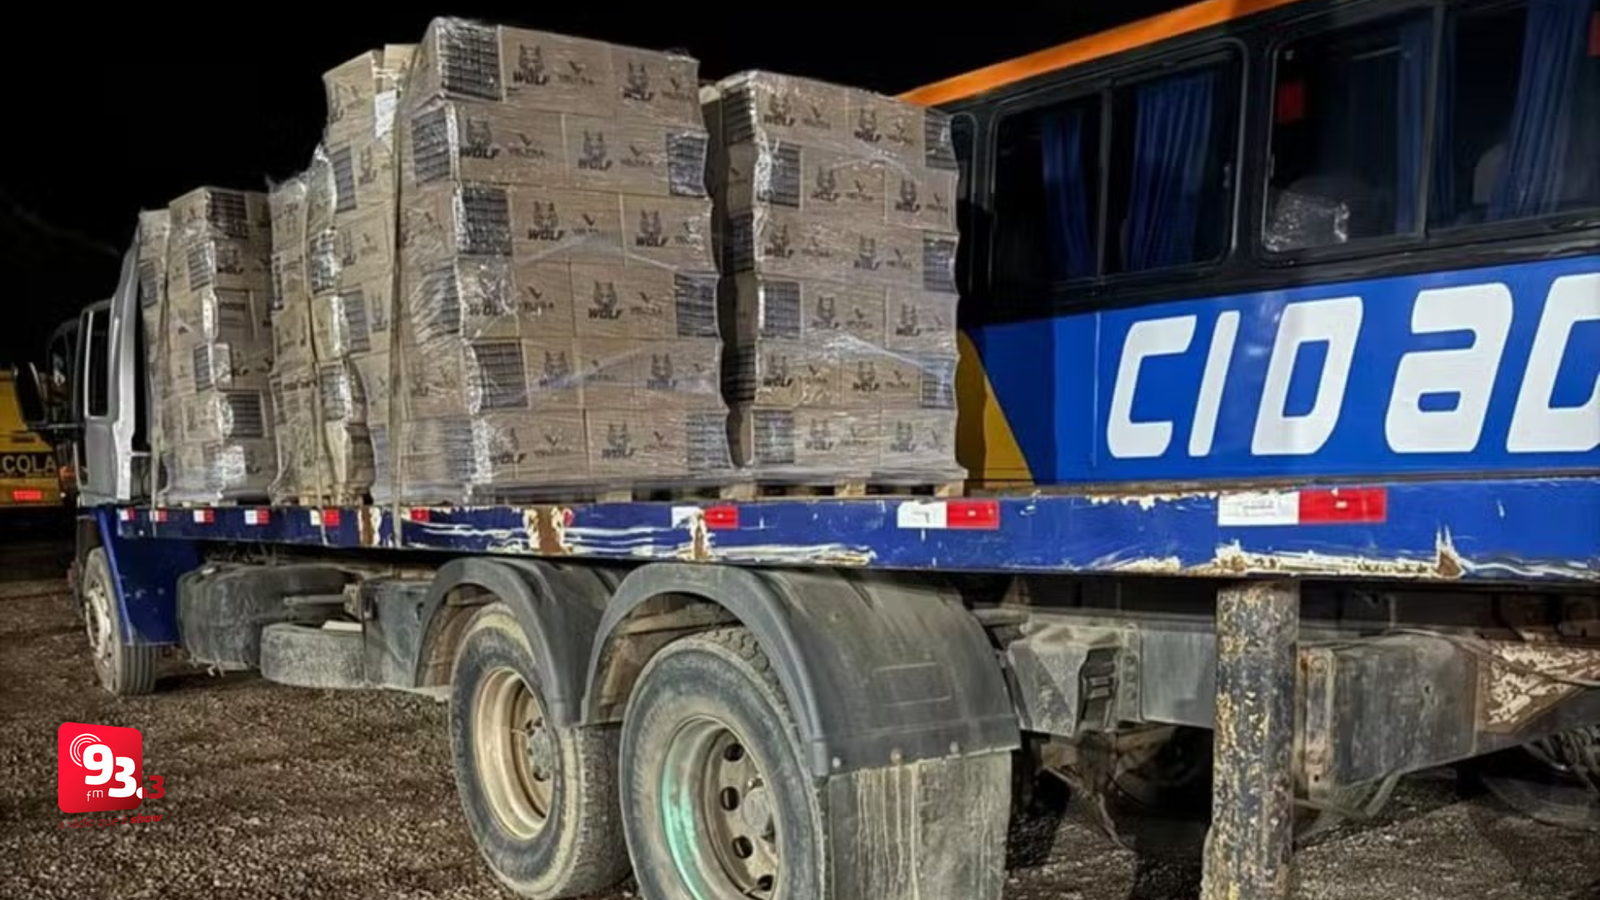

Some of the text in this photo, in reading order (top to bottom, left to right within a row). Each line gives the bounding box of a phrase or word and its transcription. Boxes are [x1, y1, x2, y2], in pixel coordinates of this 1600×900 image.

[513, 70, 549, 86] WOLF
[459, 147, 500, 159] WOLF
[528, 229, 565, 241] WOLF
[635, 235, 669, 247] WOLF
[588, 308, 622, 320] WOLF
[2, 455, 57, 473] COLA
